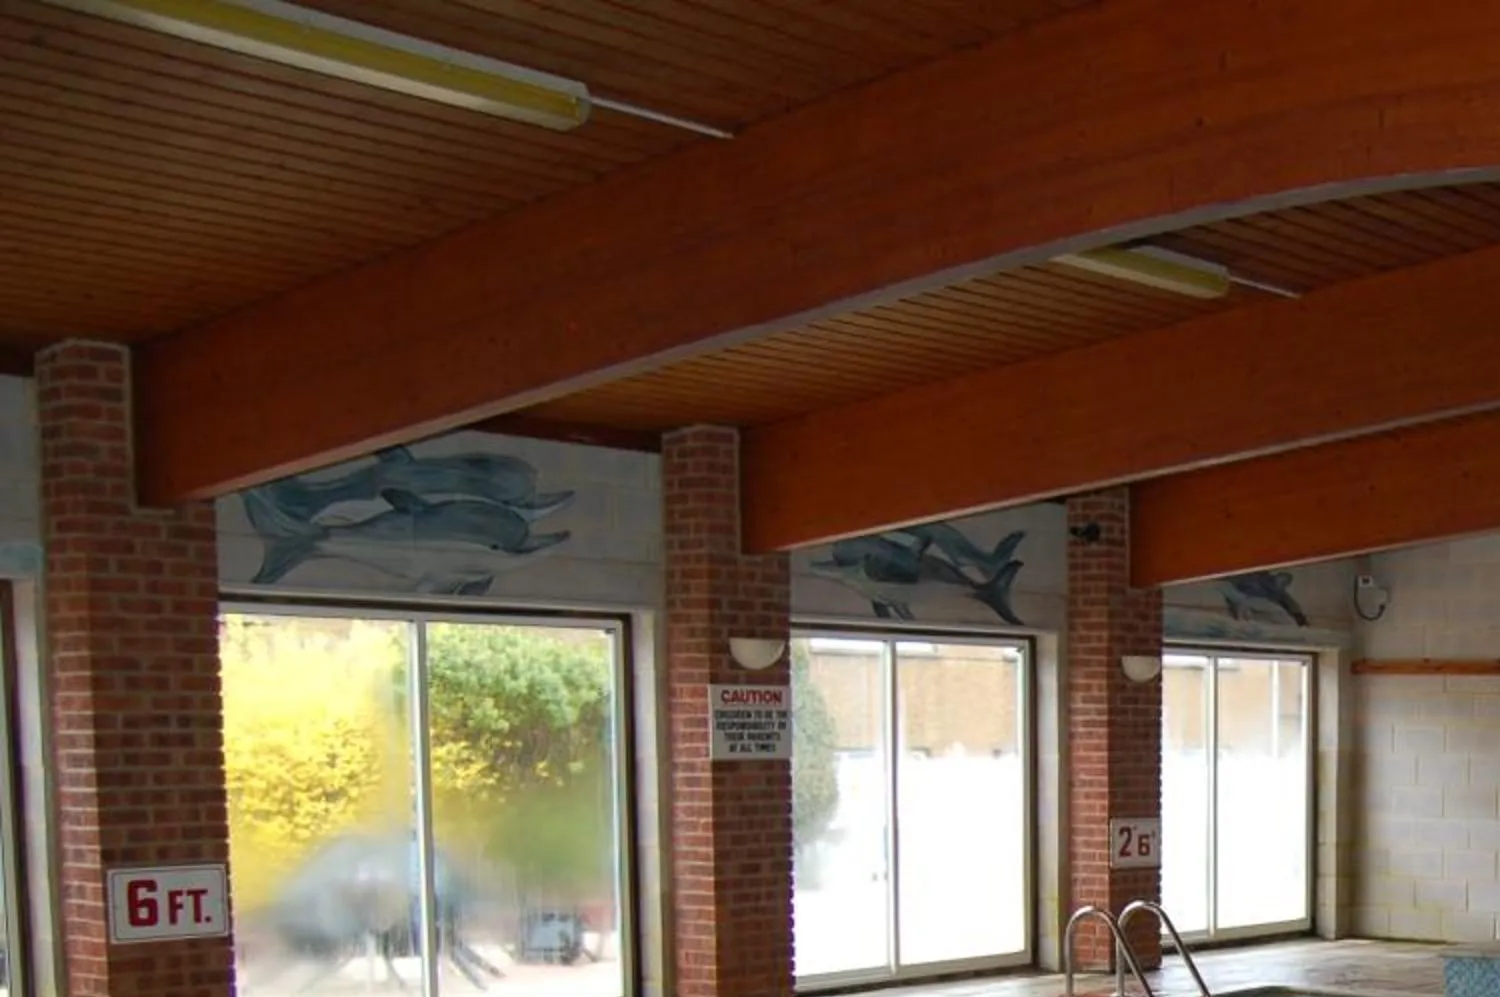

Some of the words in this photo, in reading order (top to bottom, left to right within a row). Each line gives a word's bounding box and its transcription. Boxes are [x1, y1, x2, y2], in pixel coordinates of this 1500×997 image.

[721, 689, 782, 704] CAUTION
[127, 879, 159, 926] 6
[167, 889, 212, 925] FT.
